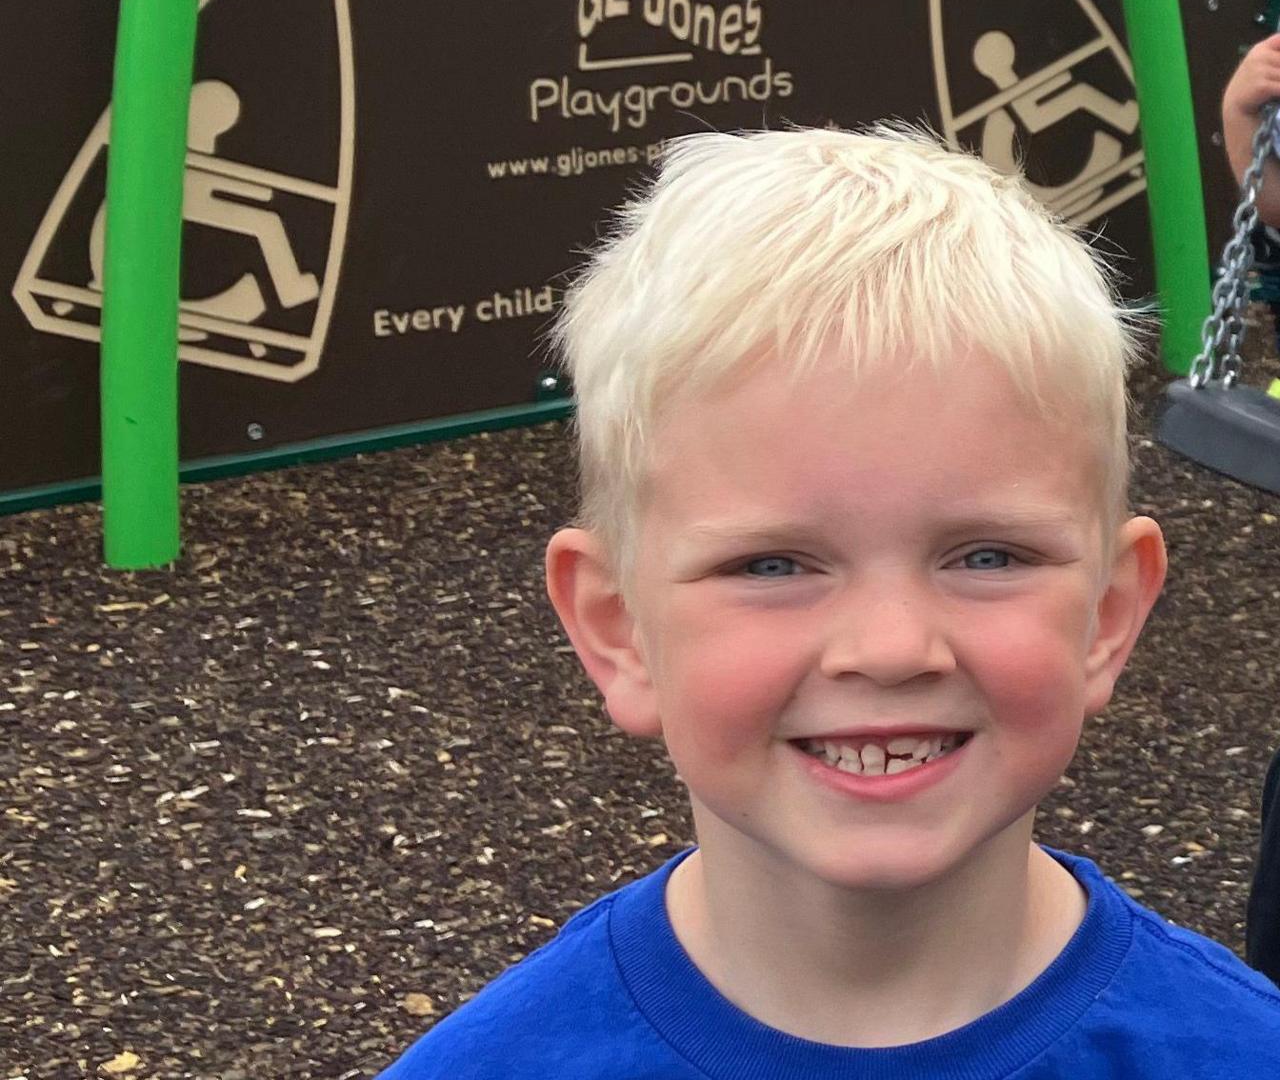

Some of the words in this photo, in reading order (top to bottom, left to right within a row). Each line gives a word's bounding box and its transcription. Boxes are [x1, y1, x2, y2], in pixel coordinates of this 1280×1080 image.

[530, 58, 793, 133] Playgrounds
[373, 304, 466, 337] Every
[475, 285, 553, 321] child
